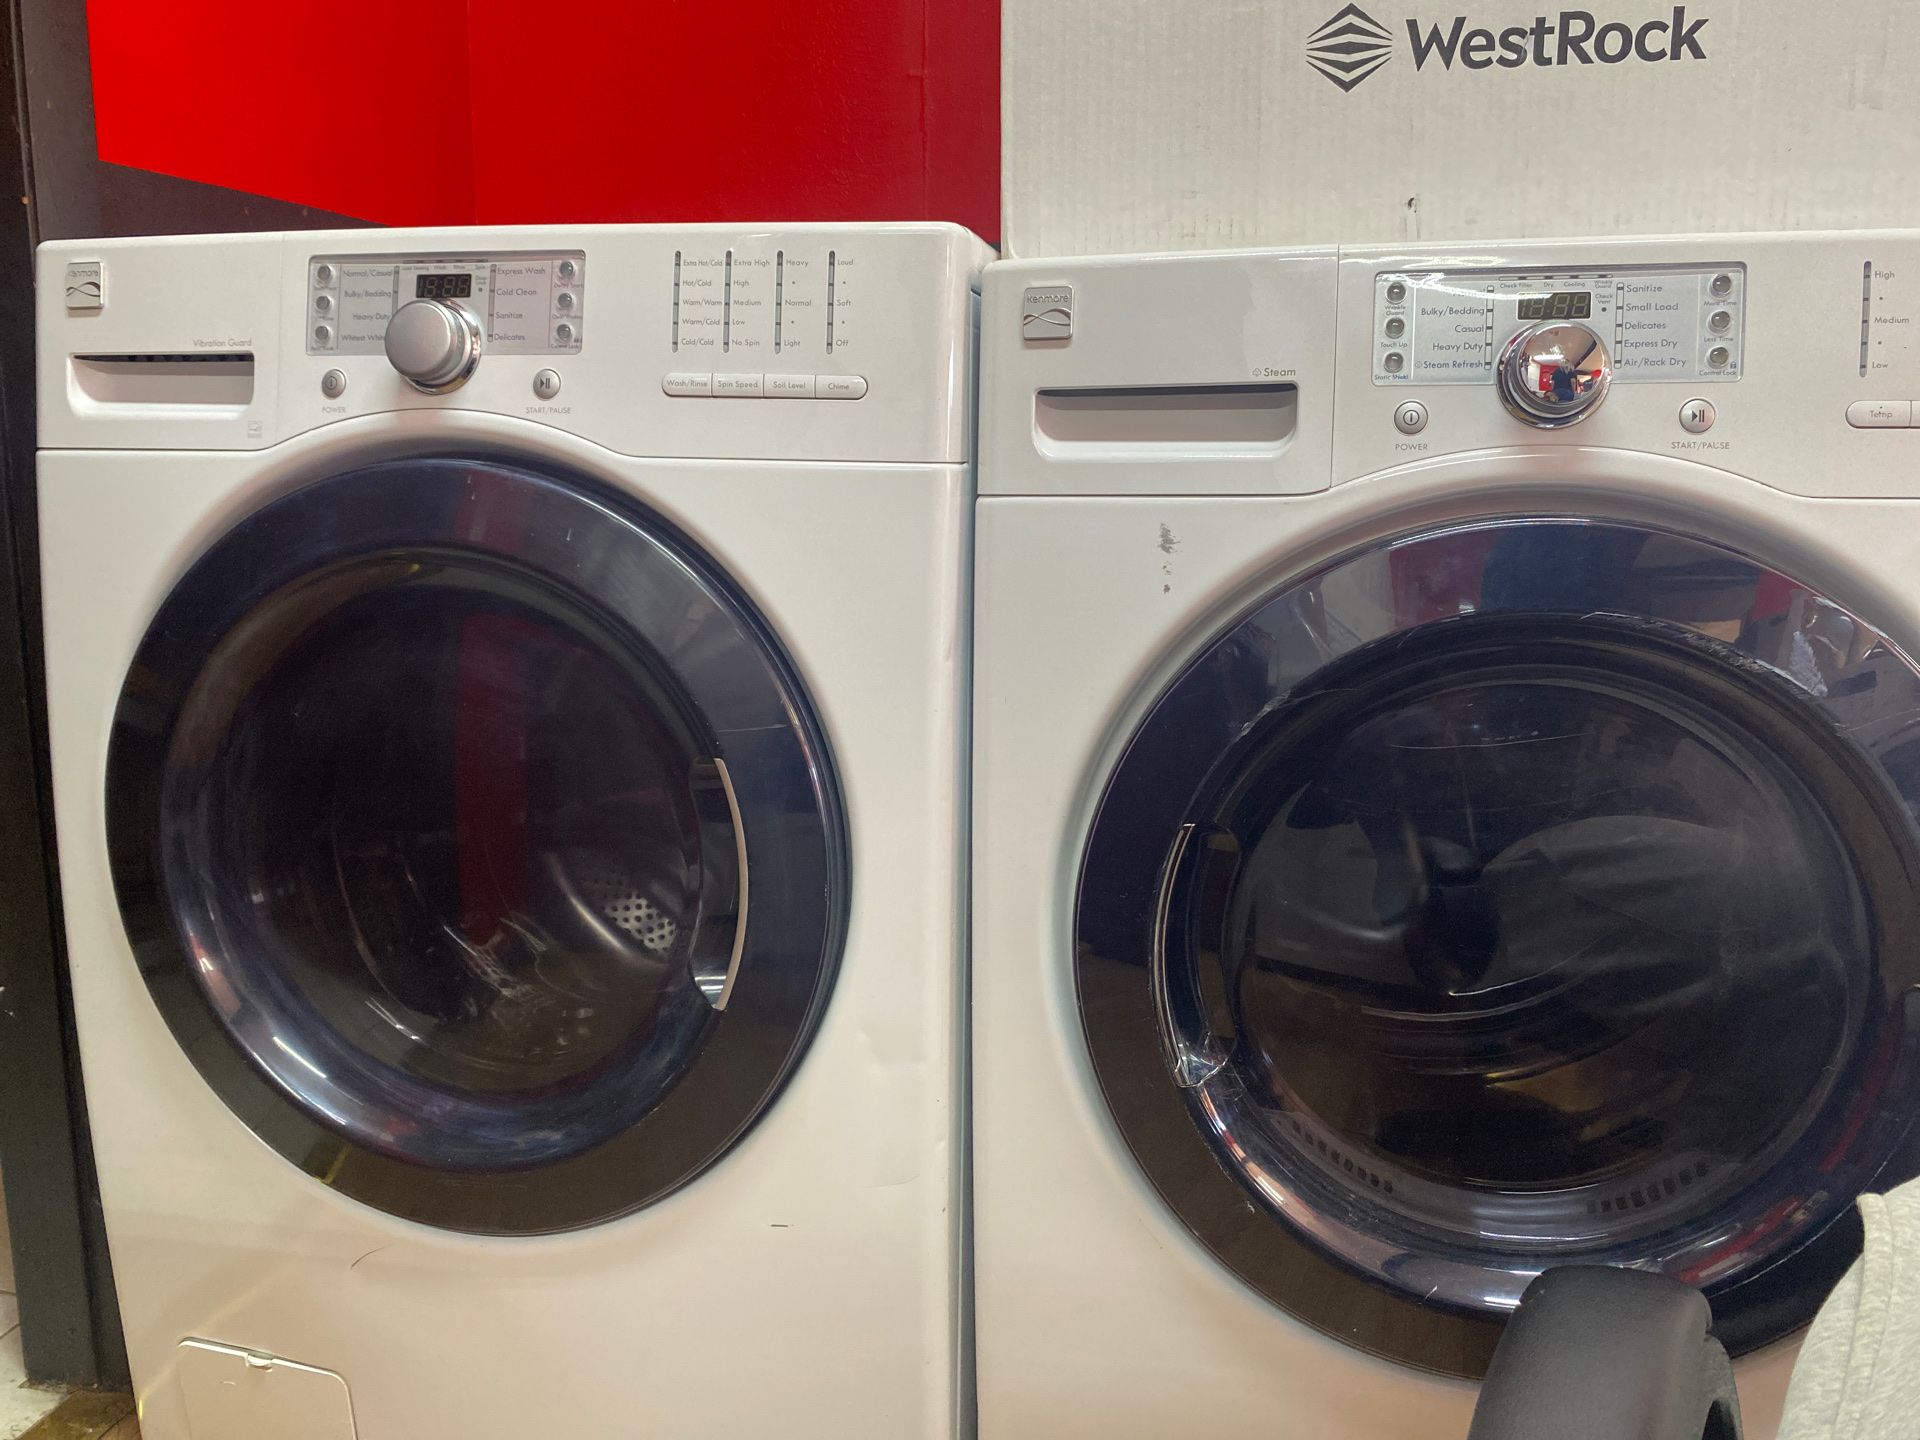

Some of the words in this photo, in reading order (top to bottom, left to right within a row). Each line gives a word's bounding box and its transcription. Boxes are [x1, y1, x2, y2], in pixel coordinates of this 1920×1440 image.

[1405, 5, 1710, 72] WestRock
[683, 259, 697, 267] Extra
[698, 259, 723, 267] Hot/Cold
[734, 259, 753, 267] Extra
[754, 259, 770, 268] High
[786, 259, 809, 268] Heavy
[497, 267, 524, 276] Express
[525, 266, 546, 274] Wash
[1874, 270, 1895, 280] High
[682, 279, 712, 288] Hot/Cold
[733, 279, 750, 288] High
[496, 288, 515, 296] Cold
[515, 288, 537, 296] Clean
[1626, 284, 1663, 293] Sanitize
[344, 288, 392, 299] Bulky/Bedding
[682, 299, 722, 307] Warm/Warm
[1625, 303, 1651, 312] Small
[1655, 303, 1679, 311] Load
[495, 311, 523, 320] Sanitize
[1420, 305, 1485, 317] Bulky/Bedding
[352, 313, 374, 321] Heavy
[1874, 316, 1910, 324] Medium
[682, 318, 720, 327] Warm/Cold
[1624, 321, 1667, 330] Delicates
[1454, 324, 1484, 333] Casual
[494, 333, 526, 341] Delicates
[193, 339, 226, 348] Vibration
[227, 338, 252, 347] Guard
[681, 338, 714, 347] Cold/Cold
[744, 339, 760, 348] Spin
[783, 339, 801, 348] Light
[836, 339, 849, 347] Off
[1432, 342, 1461, 352] Heavy
[1463, 342, 1483, 352] Duty
[1624, 340, 1659, 349] Express
[1660, 339, 1678, 349] Dry
[1423, 360, 1450, 369] Steam
[1452, 360, 1483, 369] Refresh
[1623, 358, 1666, 368] Air/Rack
[1669, 358, 1687, 368] Dry
[1872, 361, 1889, 369] Low
[1263, 367, 1296, 377] Steam
[666, 380, 708, 388] Wash/Rinse
[717, 380, 734, 389] Spin
[735, 380, 758, 389] Speed
[773, 381, 786, 389] Soil
[787, 381, 806, 389] Level
[827, 382, 850, 391] Chime
[1870, 410, 1893, 420] Temp
[1395, 443, 1428, 451] POWER
[1671, 441, 1730, 451] START/PAUSE
